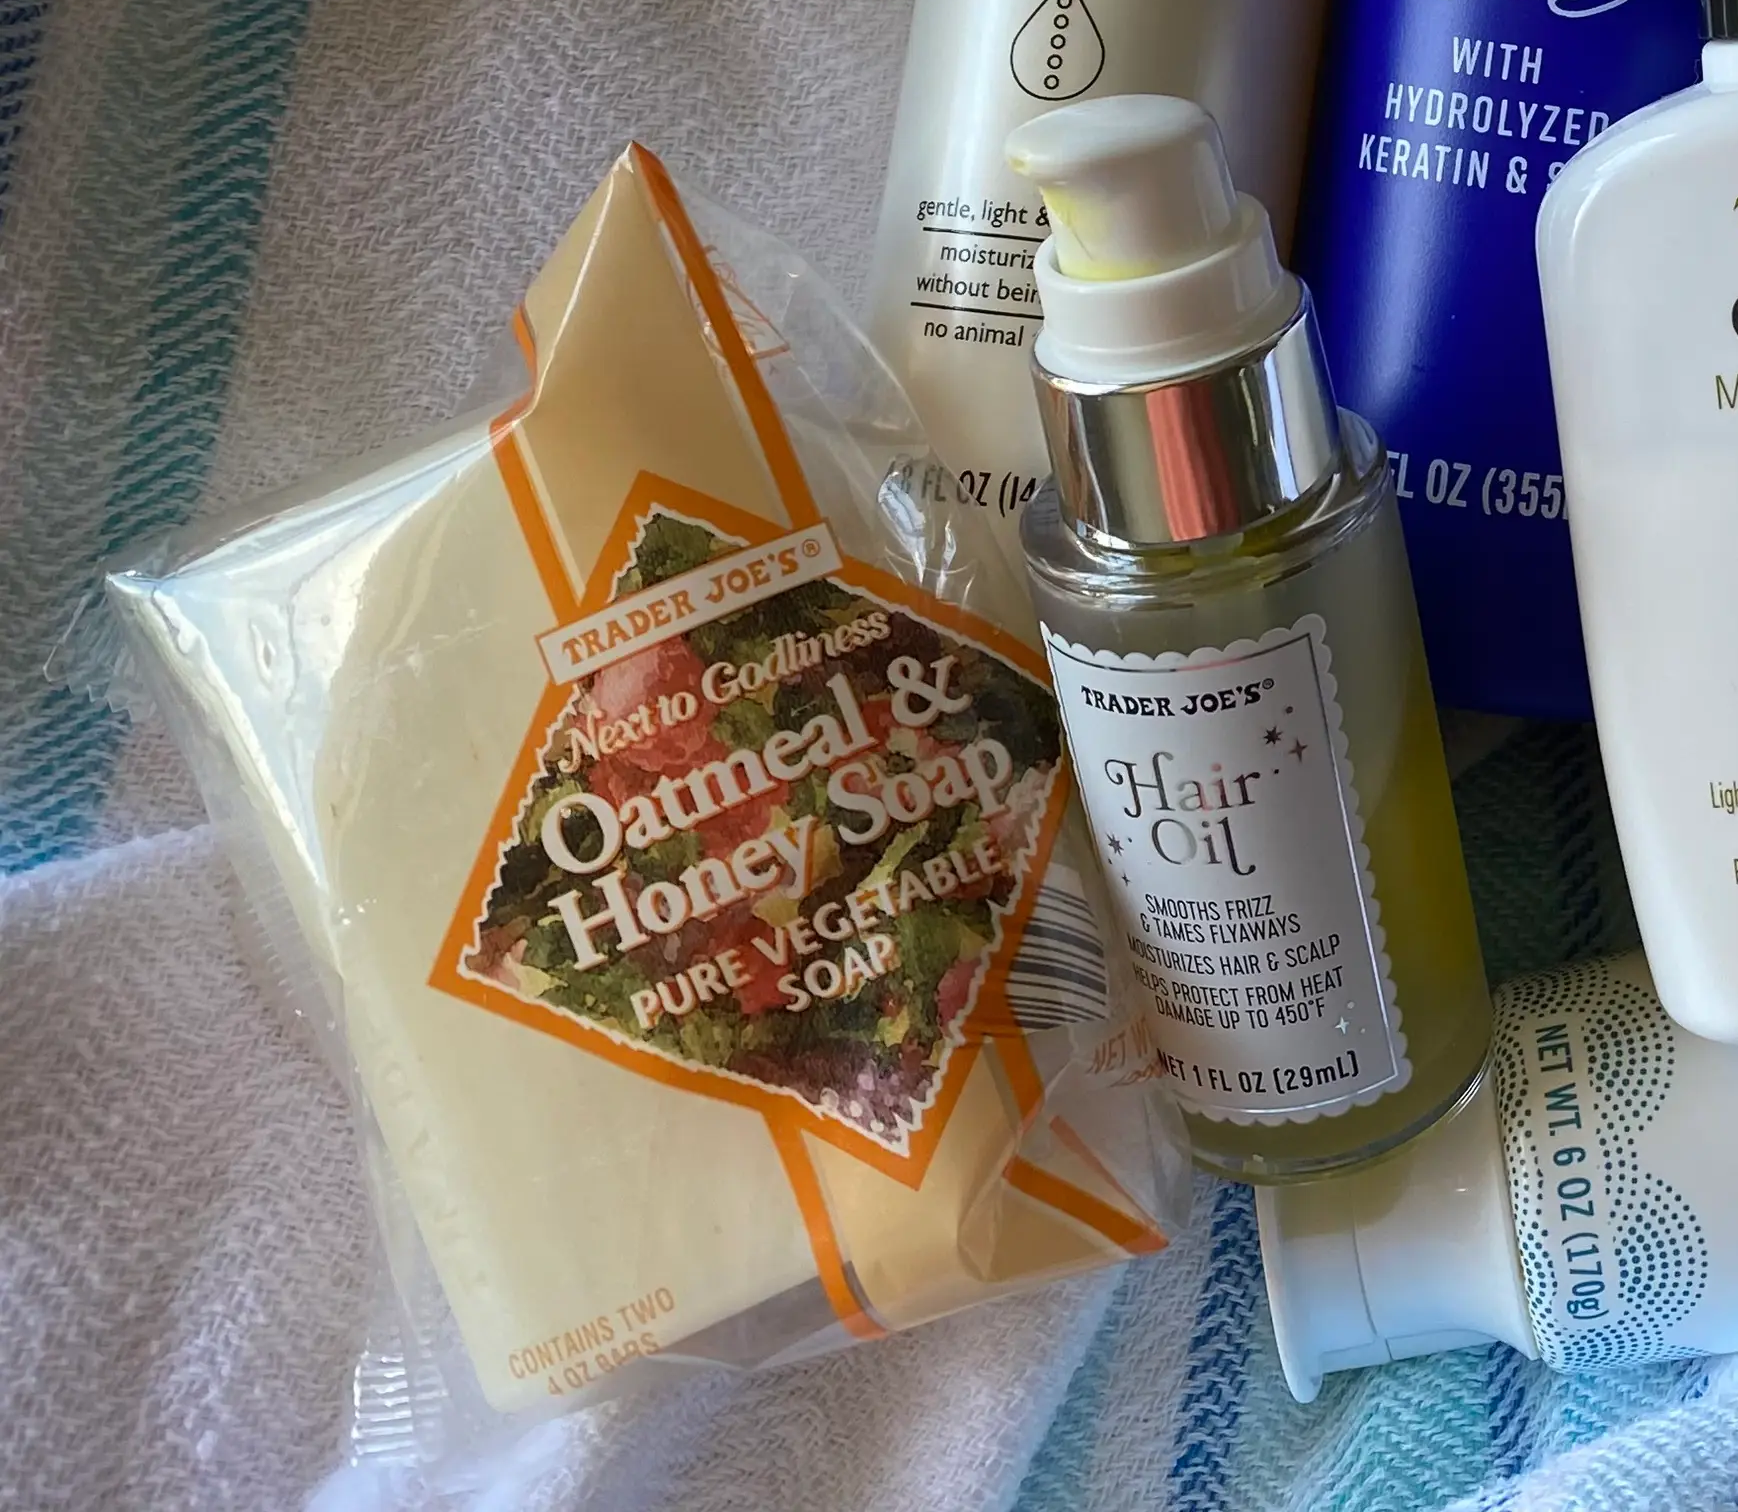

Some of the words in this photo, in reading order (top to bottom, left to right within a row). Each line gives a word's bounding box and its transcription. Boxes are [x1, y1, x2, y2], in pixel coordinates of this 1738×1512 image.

[1452, 36, 1543, 85] WITH
[1358, 133, 1489, 189] KERATIN
[1505, 155, 1527, 195] &
[917, 198, 975, 222] gentle,
[982, 199, 1028, 228] light
[1035, 204, 1050, 227] &
[940, 244, 1035, 270] moisturiz
[917, 274, 989, 298] without
[924, 320, 948, 338] no
[954, 325, 1024, 347] animal
[957, 469, 991, 506] OZ
[999, 471, 1036, 518] (14
[1425, 458, 1472, 508] OZ
[1481, 467, 1569, 520] (355
[562, 589, 697, 666] TRADER
[557, 703, 657, 773] Next
[657, 691, 698, 726] to
[701, 611, 892, 705] Godliness
[1080, 684, 1176, 717] TRADER
[541, 672, 878, 876] Oatmeal
[886, 653, 974, 728] &
[1104, 751, 1261, 818] Hair
[547, 813, 819, 972] Honey
[826, 737, 1013, 846] Soap
[1150, 816, 1257, 876] Oil
[1139, 912, 1150, 933] &
[1152, 916, 1205, 944] TAMES
[1209, 913, 1301, 944] FLYAWAYS
[1145, 893, 1221, 921] SMOOTHS
[1225, 894, 1275, 921] FRIZZ
[630, 947, 755, 1030] PURE
[751, 834, 1003, 968] VEGETABLE
[1126, 931, 1215, 976] MOISTURIZES
[1219, 954, 1261, 976] HAIR
[1266, 951, 1280, 972] &
[1284, 933, 1341, 968] SCALP
[777, 932, 897, 1014] SOAP
[1132, 961, 1170, 997] HELPS
[1172, 981, 1239, 1007] PROTECT
[1245, 981, 1295, 1007] FROM
[1300, 965, 1344, 998] HEAT
[1155, 995, 1215, 1029] DAMAGE
[1219, 1010, 1240, 1030] UP
[1245, 1009, 1269, 1030] TO
[1157, 1048, 1186, 1081] NET
[1192, 1065, 1204, 1088] 1
[1210, 1067, 1232, 1093] FL
[1240, 1070, 1266, 1094] OZ
[1535, 1023, 1575, 1074] NET
[1545, 1082, 1582, 1138] WT.
[1552, 1147, 1587, 1167] 6
[1556, 1181, 1595, 1221] OZ
[1561, 1232, 1609, 1322] (170g)
[508, 1315, 615, 1380] CONTAINS
[616, 1287, 675, 1332] TWO
[563, 1360, 598, 1389] OZ
